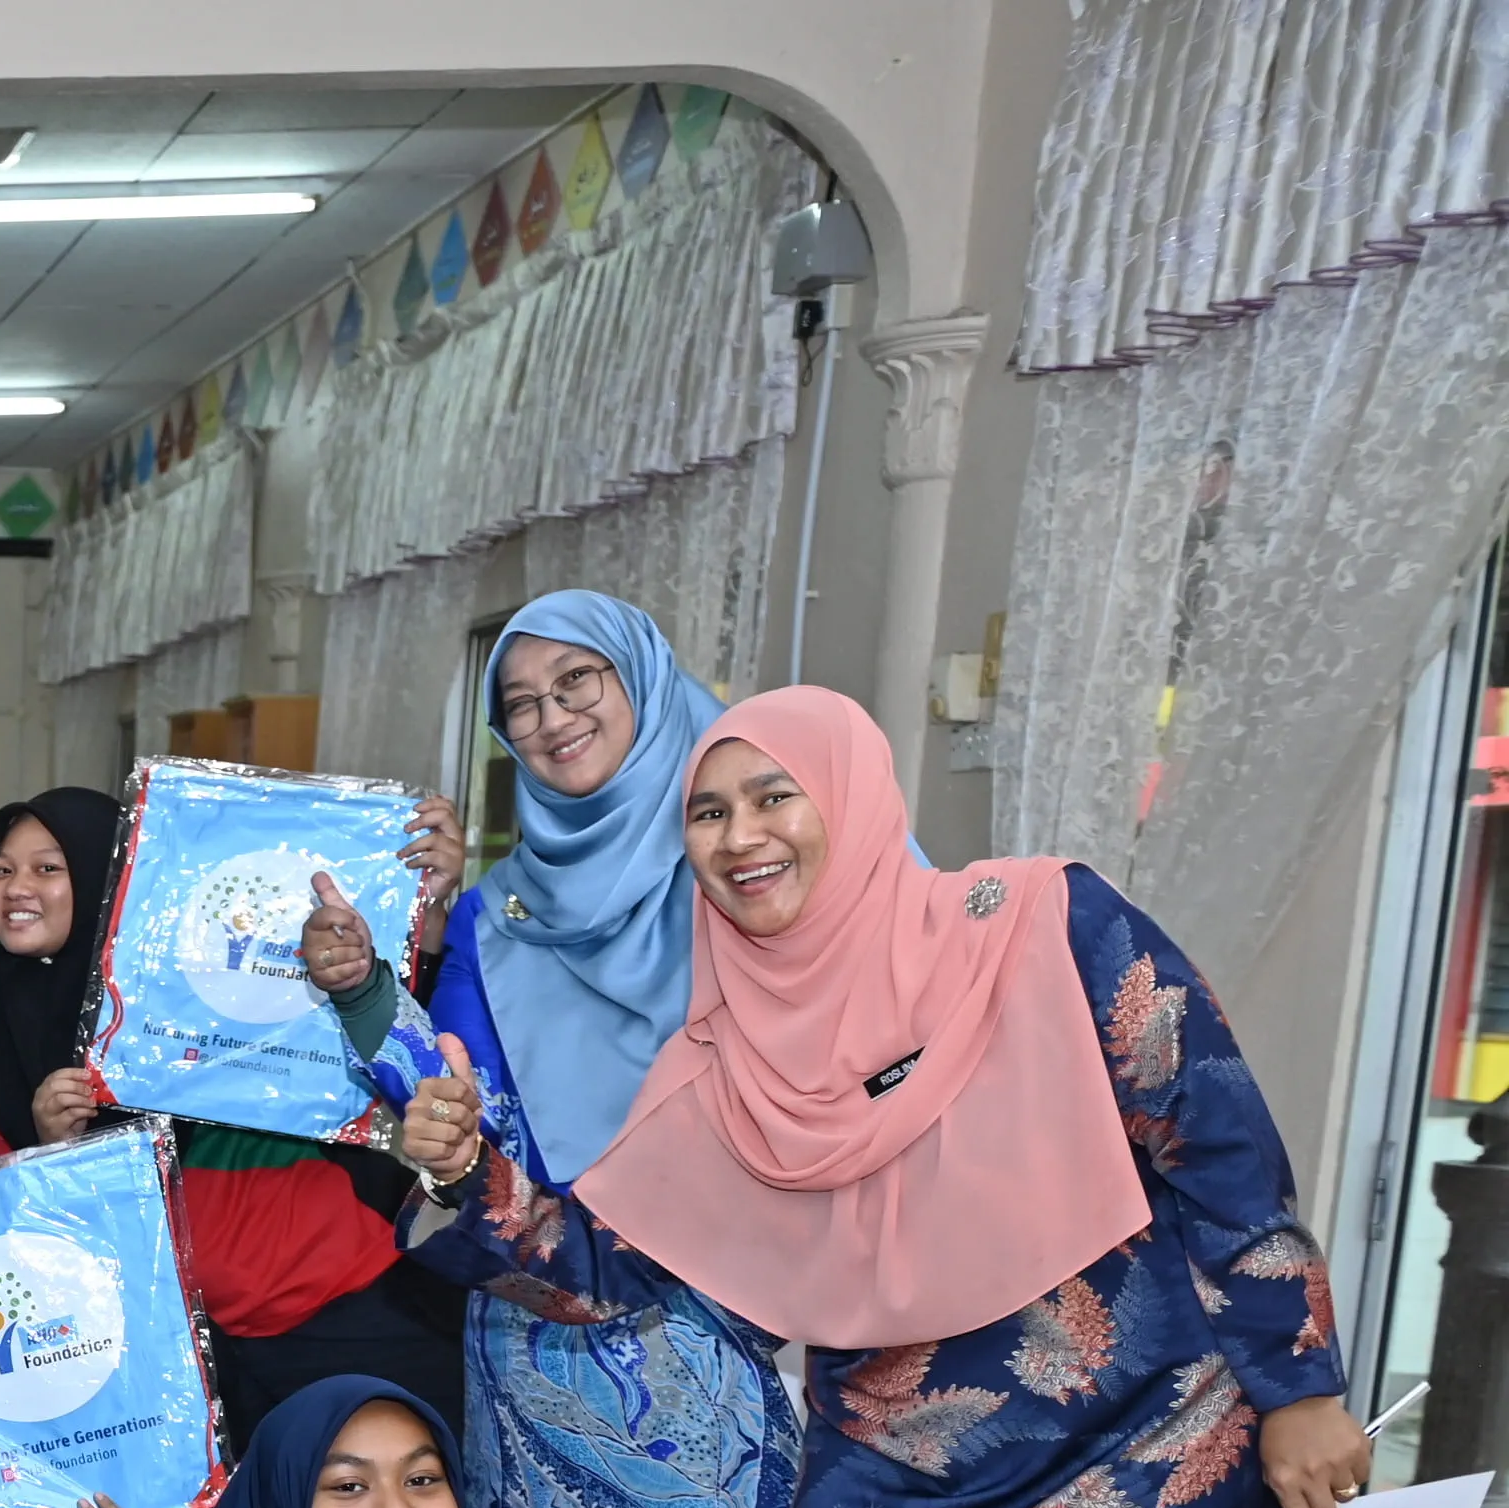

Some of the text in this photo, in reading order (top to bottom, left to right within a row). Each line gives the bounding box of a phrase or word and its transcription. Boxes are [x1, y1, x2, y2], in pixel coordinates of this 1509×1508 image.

[251, 962, 309, 982] Foundat
[143, 1022, 209, 1047] Nururing
[261, 1041, 342, 1067] Generations
[74, 1413, 165, 1445] Generations
